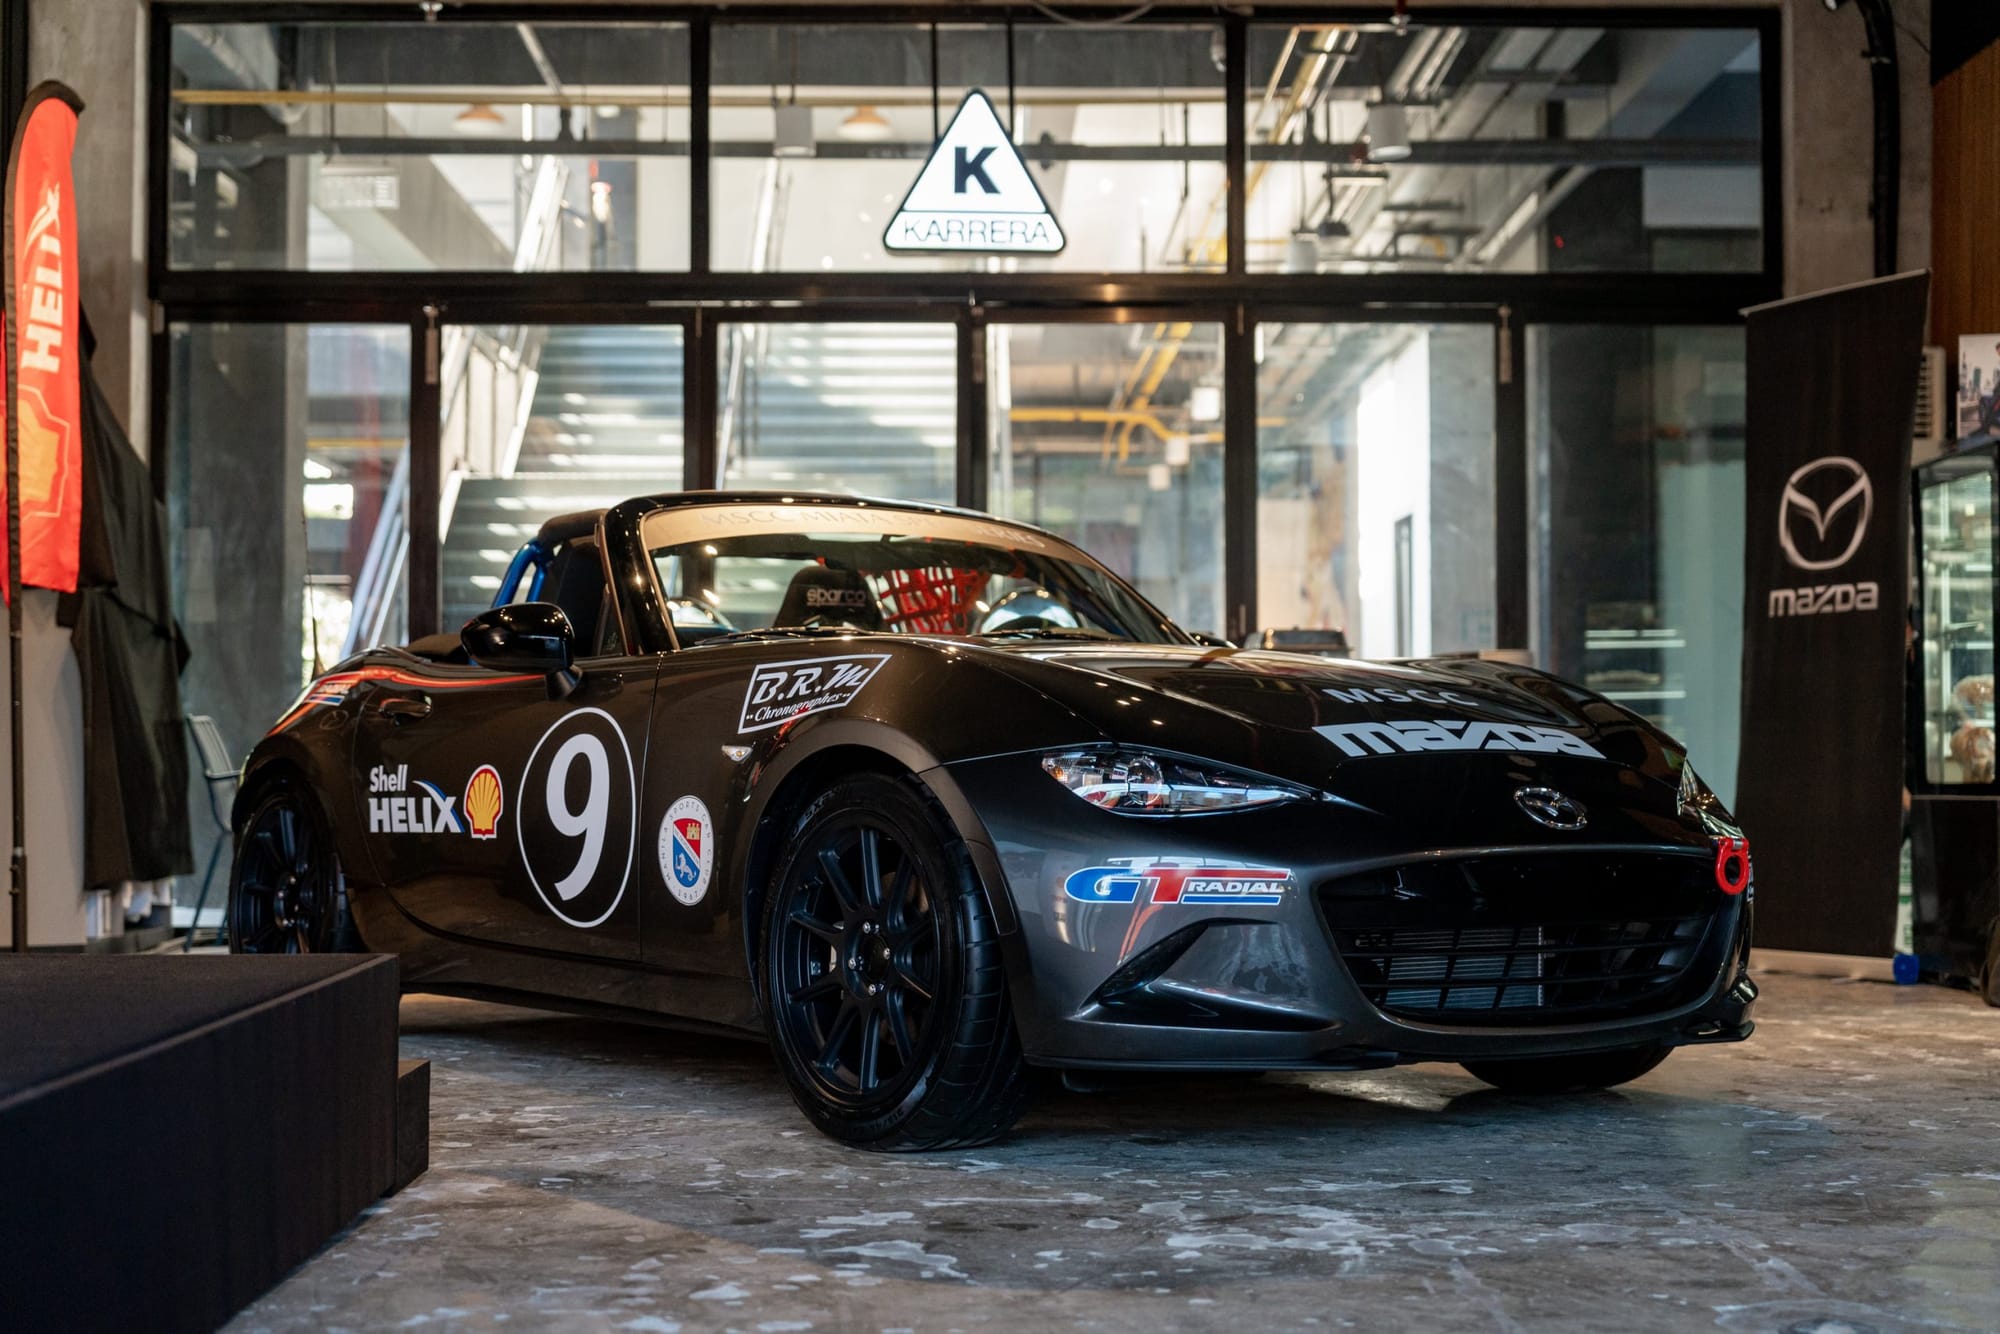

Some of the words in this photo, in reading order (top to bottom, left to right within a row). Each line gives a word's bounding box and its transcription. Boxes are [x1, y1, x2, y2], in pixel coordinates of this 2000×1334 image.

[954, 146, 1001, 194] K
[904, 219, 1050, 244] KARRERA
[20, 181, 63, 374] HELIX
[807, 588, 866, 607] sparco
[1322, 688, 1479, 706] MSCC
[369, 764, 408, 793] Shell
[368, 780, 465, 833] HELIX
[546, 733, 610, 901] 9
[1064, 866, 1190, 904] GT
[1187, 881, 1285, 893] RADIAL
